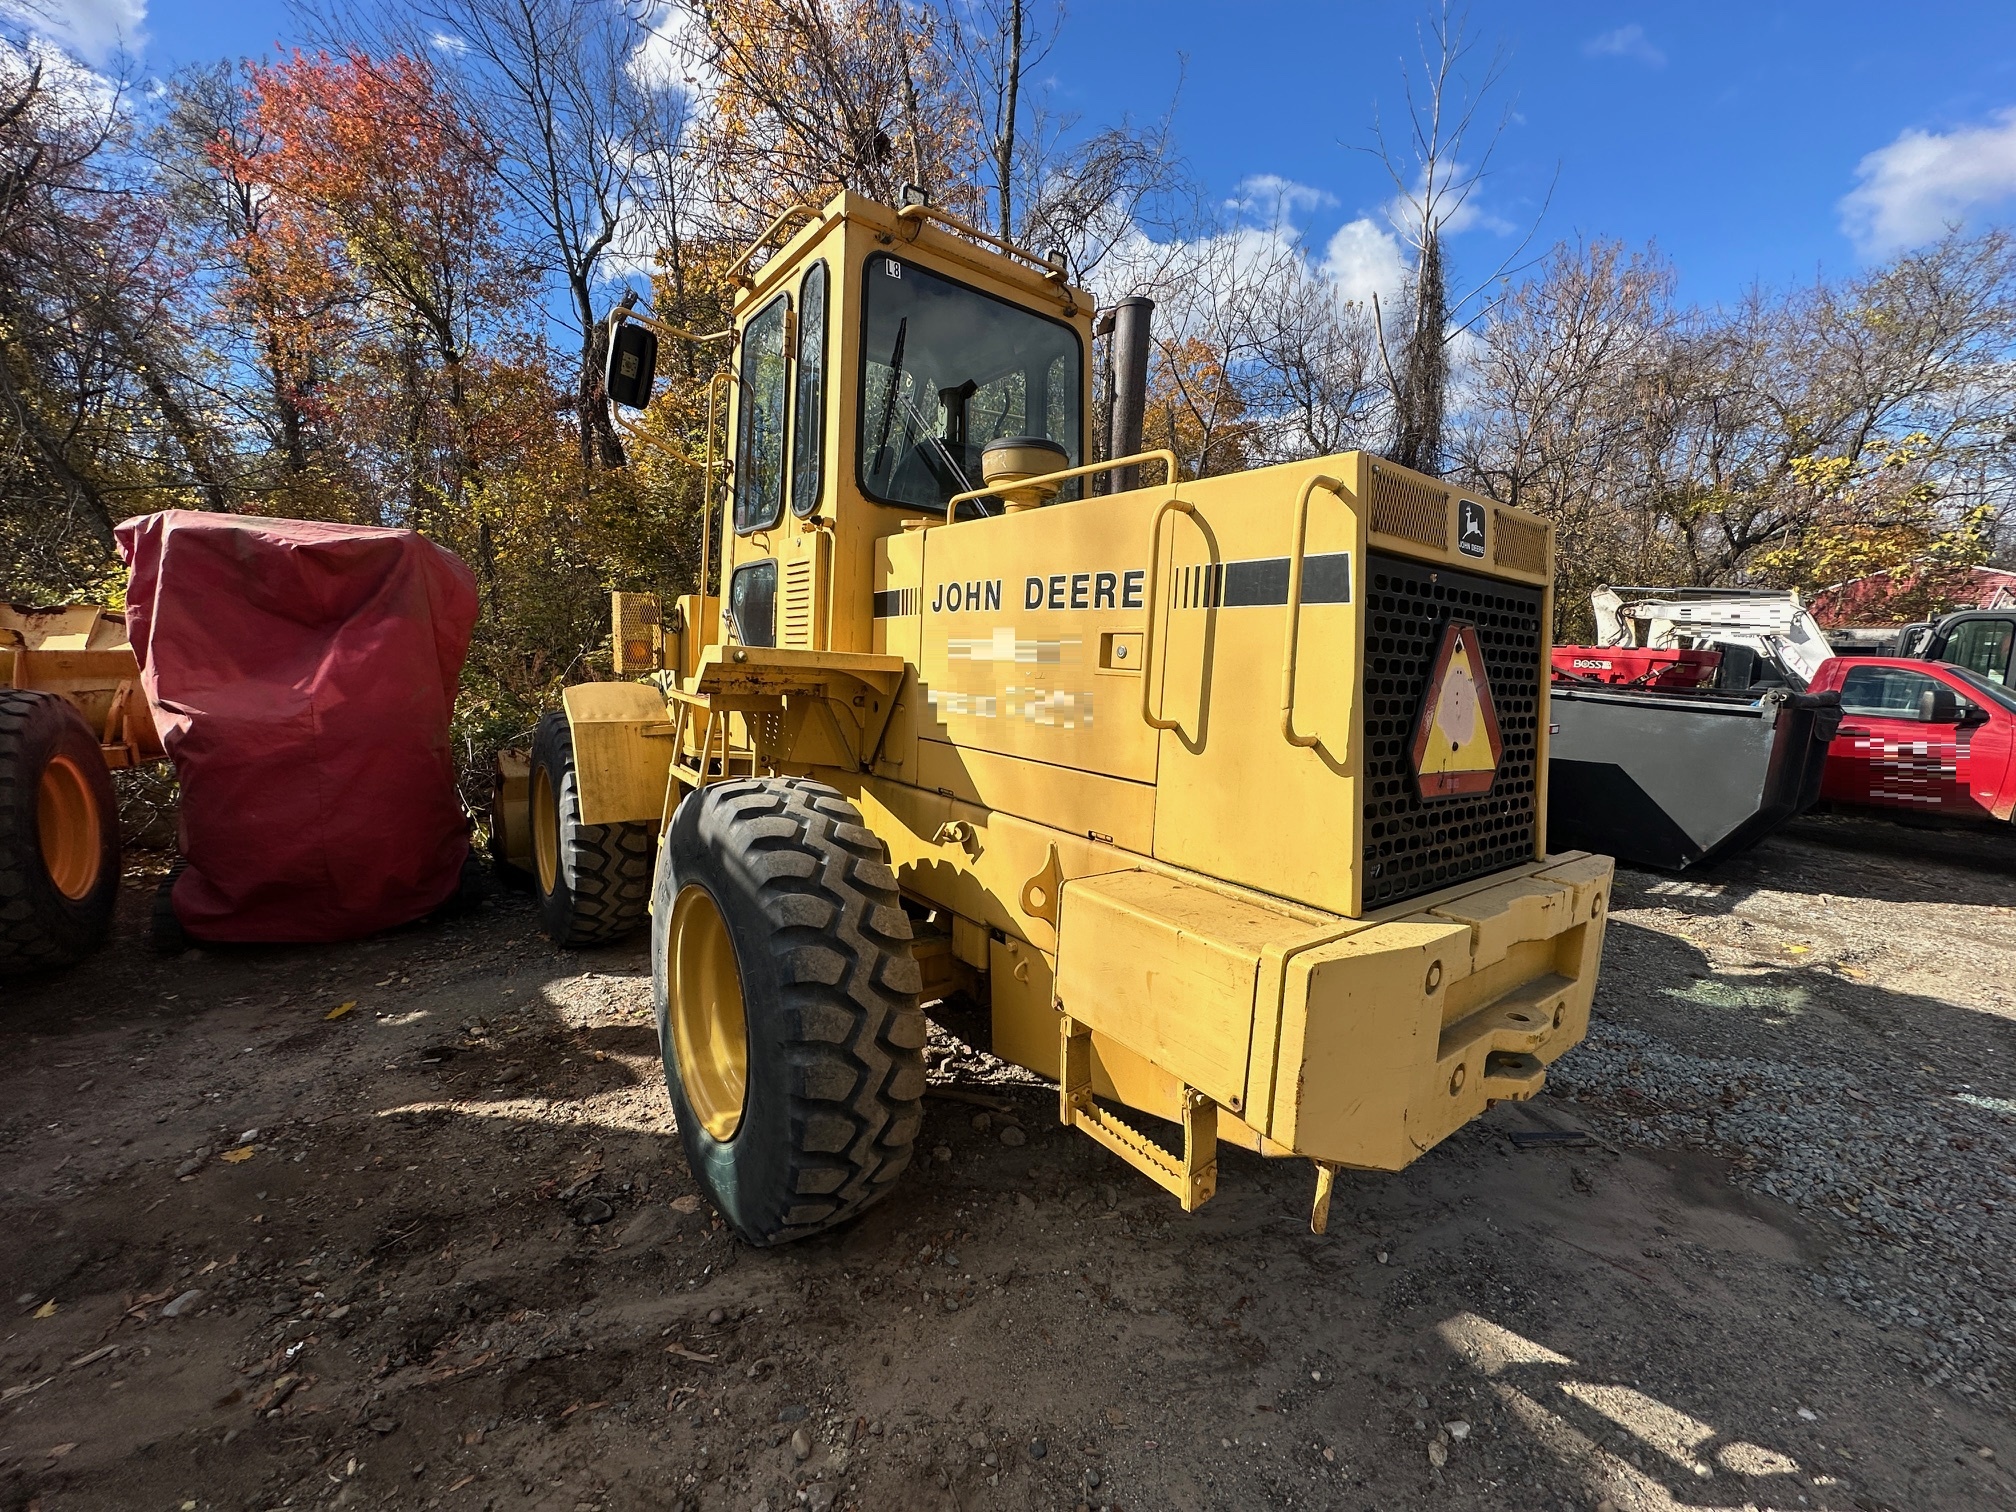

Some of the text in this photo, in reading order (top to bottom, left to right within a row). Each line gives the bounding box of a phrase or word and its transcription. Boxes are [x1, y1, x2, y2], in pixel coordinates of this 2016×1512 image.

[887, 260, 900, 277] L8
[1459, 540, 1471, 550] JOHN
[932, 570, 1145, 612] JOHN DEERE
[1573, 659, 1603, 669] BOSS
